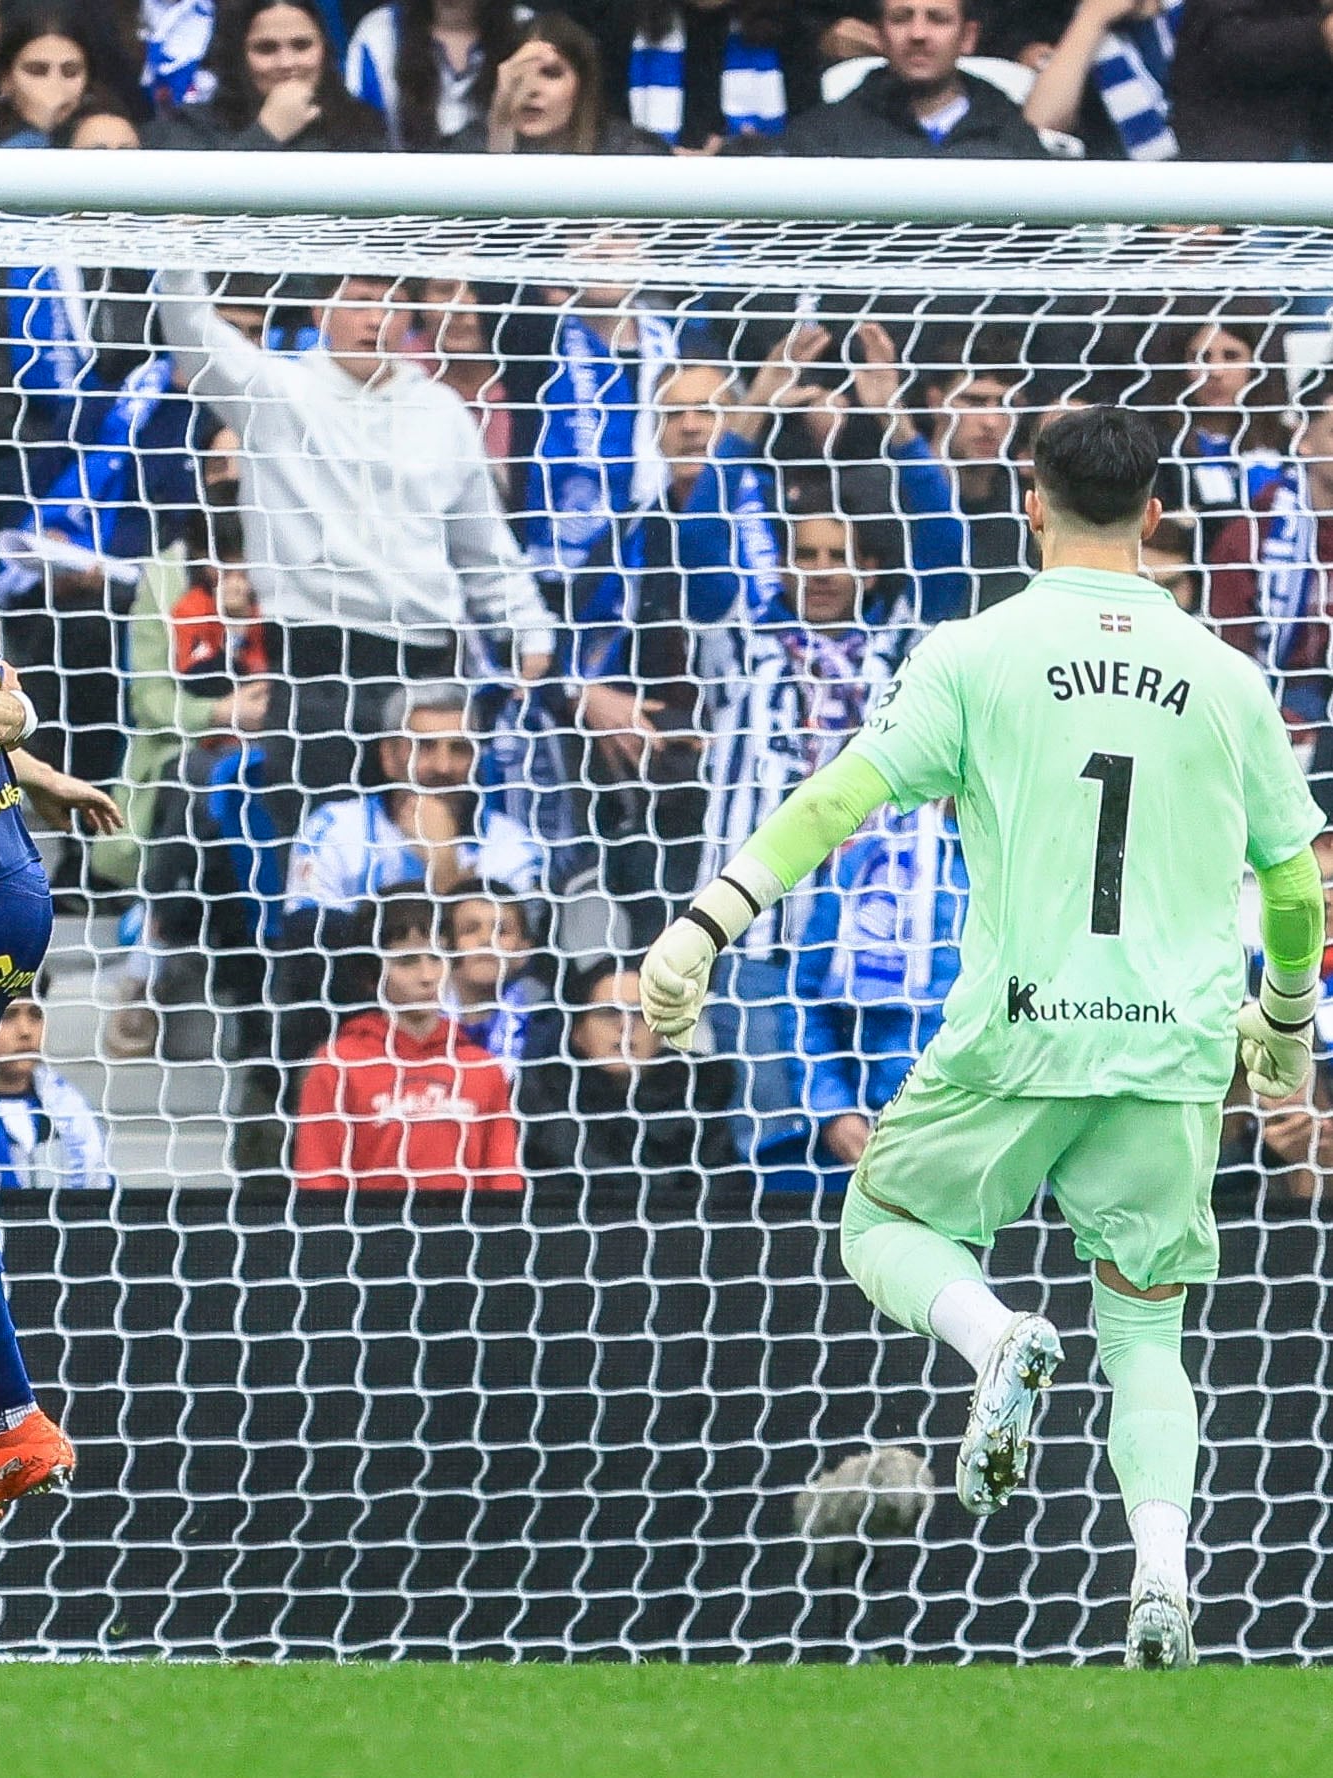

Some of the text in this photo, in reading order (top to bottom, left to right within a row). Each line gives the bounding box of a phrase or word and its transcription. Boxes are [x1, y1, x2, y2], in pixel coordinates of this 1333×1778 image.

[1047, 660, 1190, 716] SIVERA
[1079, 752, 1134, 936] 1
[1007, 975, 1178, 1024] Kutxabank
